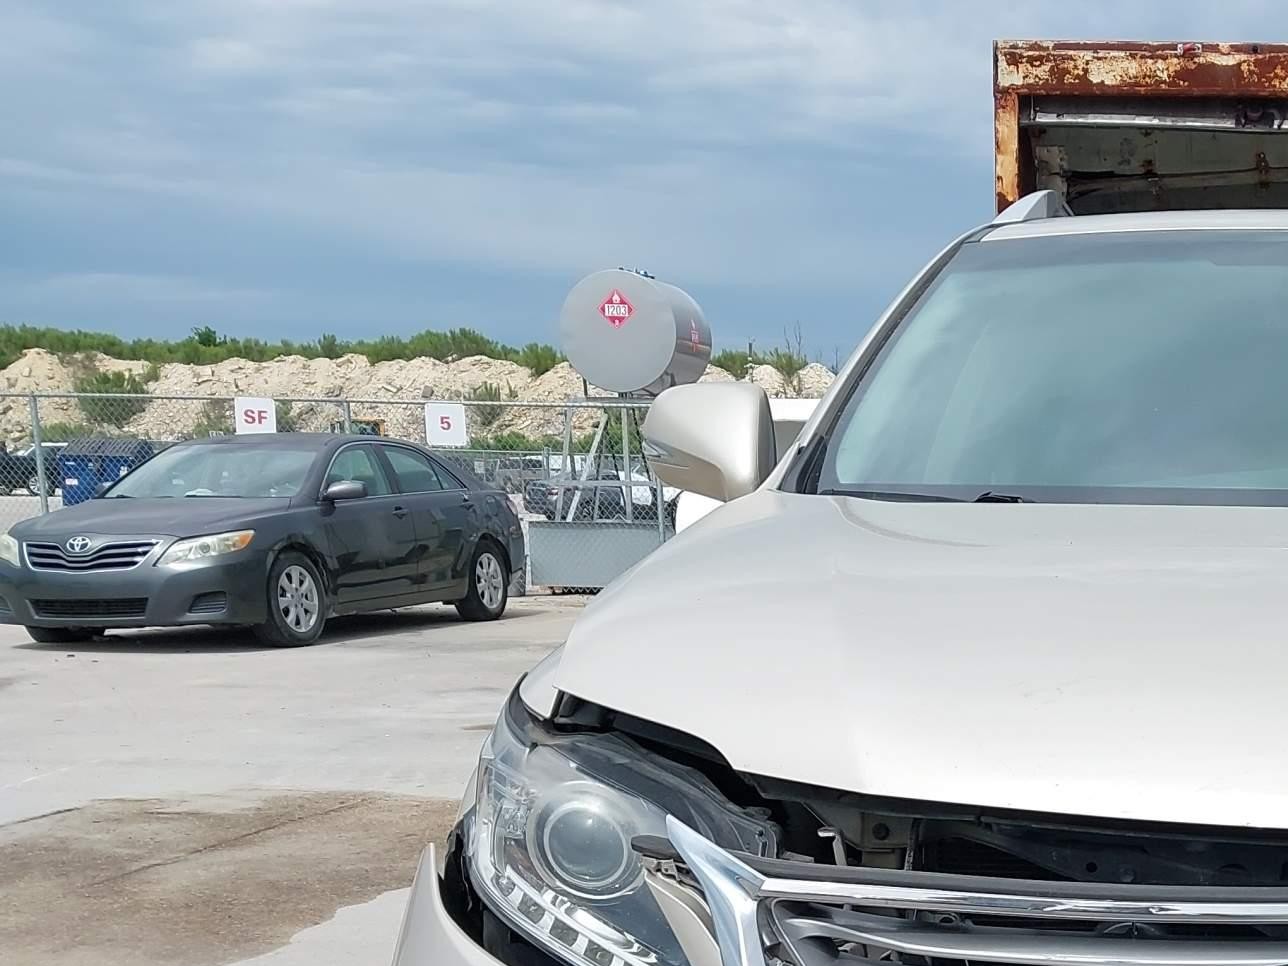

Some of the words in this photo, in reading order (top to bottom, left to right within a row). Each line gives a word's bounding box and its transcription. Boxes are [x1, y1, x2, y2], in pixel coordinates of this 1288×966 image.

[606, 305, 627, 316] 1203
[244, 409, 268, 425] SF
[440, 416, 452, 430] 5
